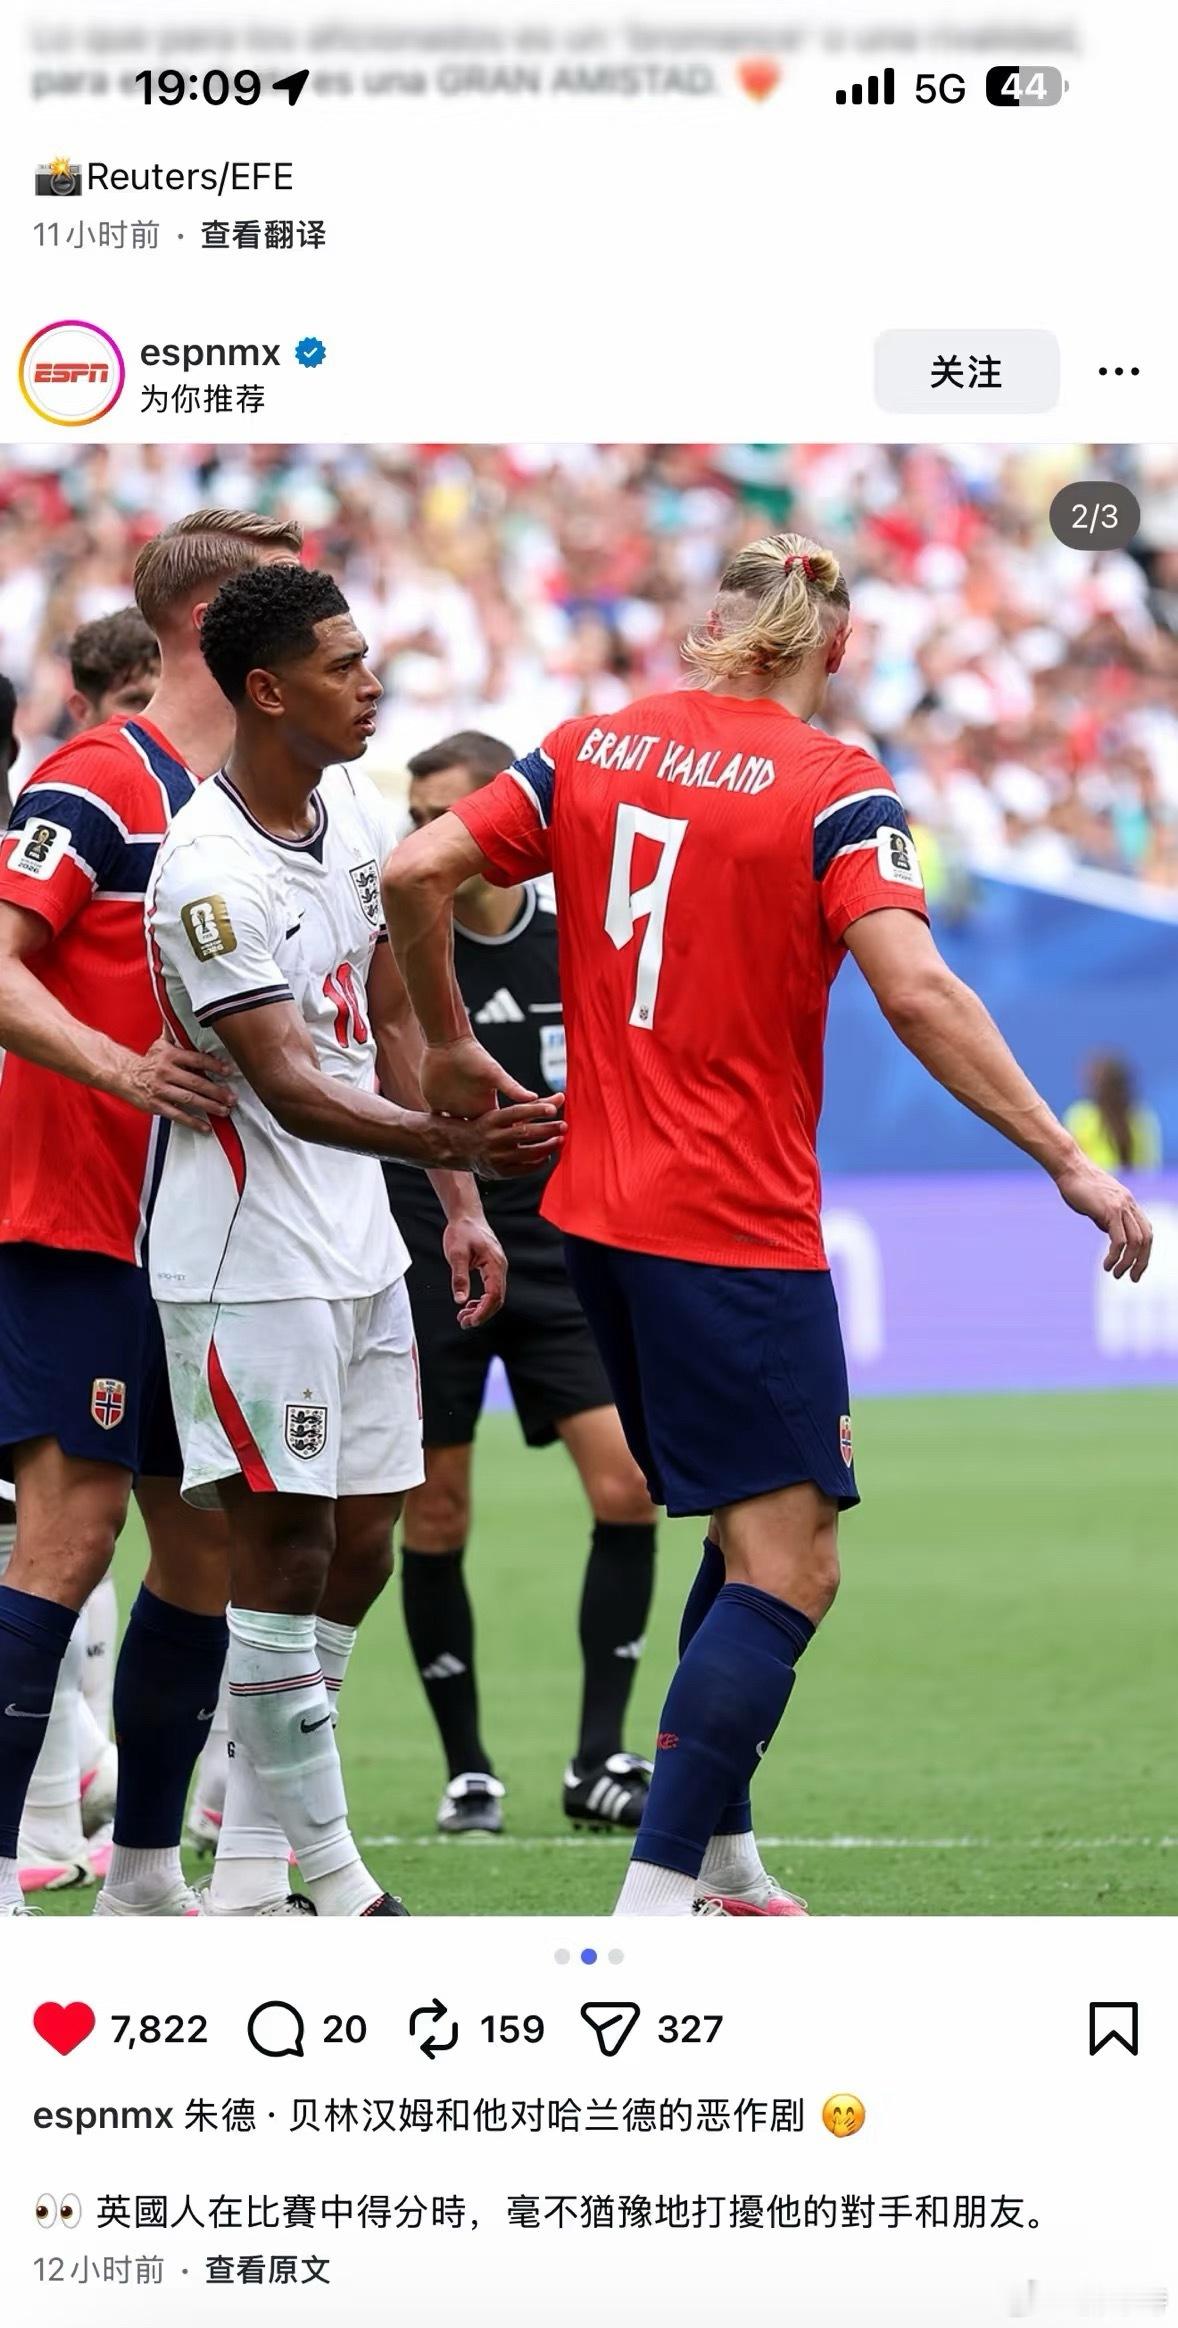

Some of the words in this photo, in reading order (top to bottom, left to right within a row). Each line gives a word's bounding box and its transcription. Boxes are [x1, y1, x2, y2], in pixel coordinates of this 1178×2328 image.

[656, 740, 776, 795] HAALAND
[605, 801, 689, 1031] 9
[322, 961, 368, 1048] 10
